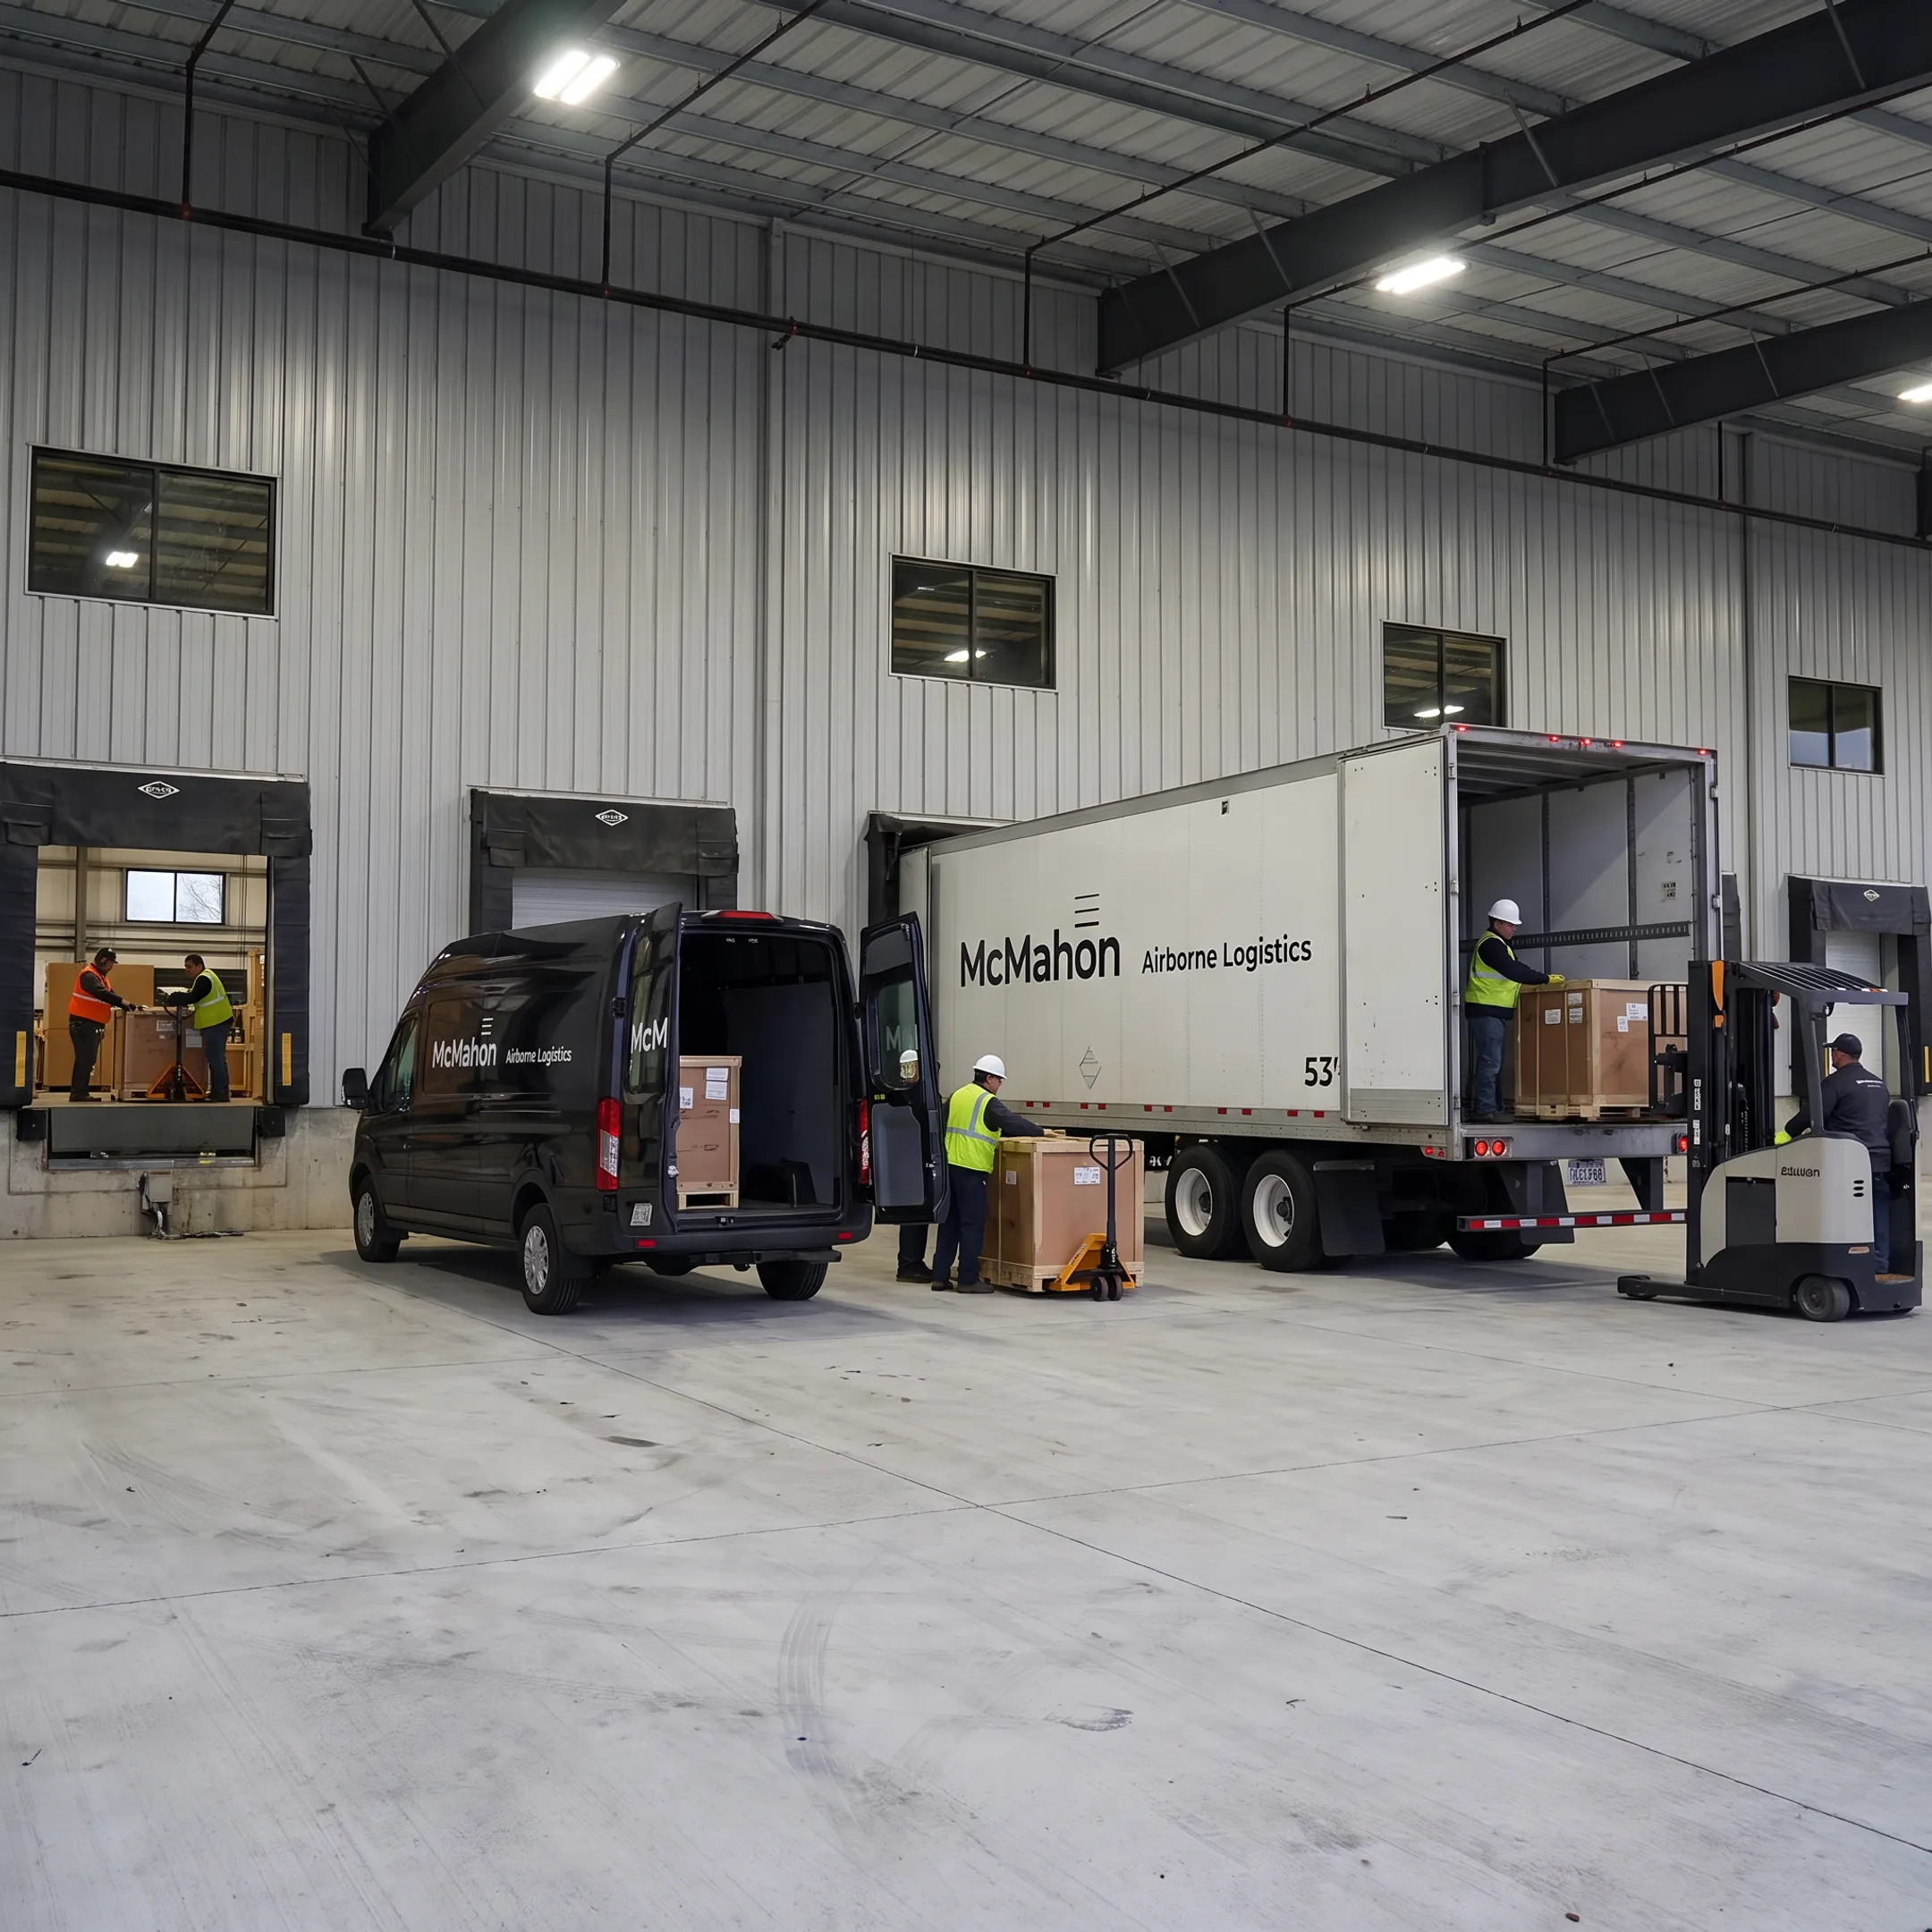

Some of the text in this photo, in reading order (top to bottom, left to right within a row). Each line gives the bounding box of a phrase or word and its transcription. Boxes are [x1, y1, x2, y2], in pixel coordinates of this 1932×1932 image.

[961, 928, 1312, 987] McMahon Airborne Logistics
[432, 1037, 497, 1068] McMahon
[538, 1046, 572, 1066] Logistics
